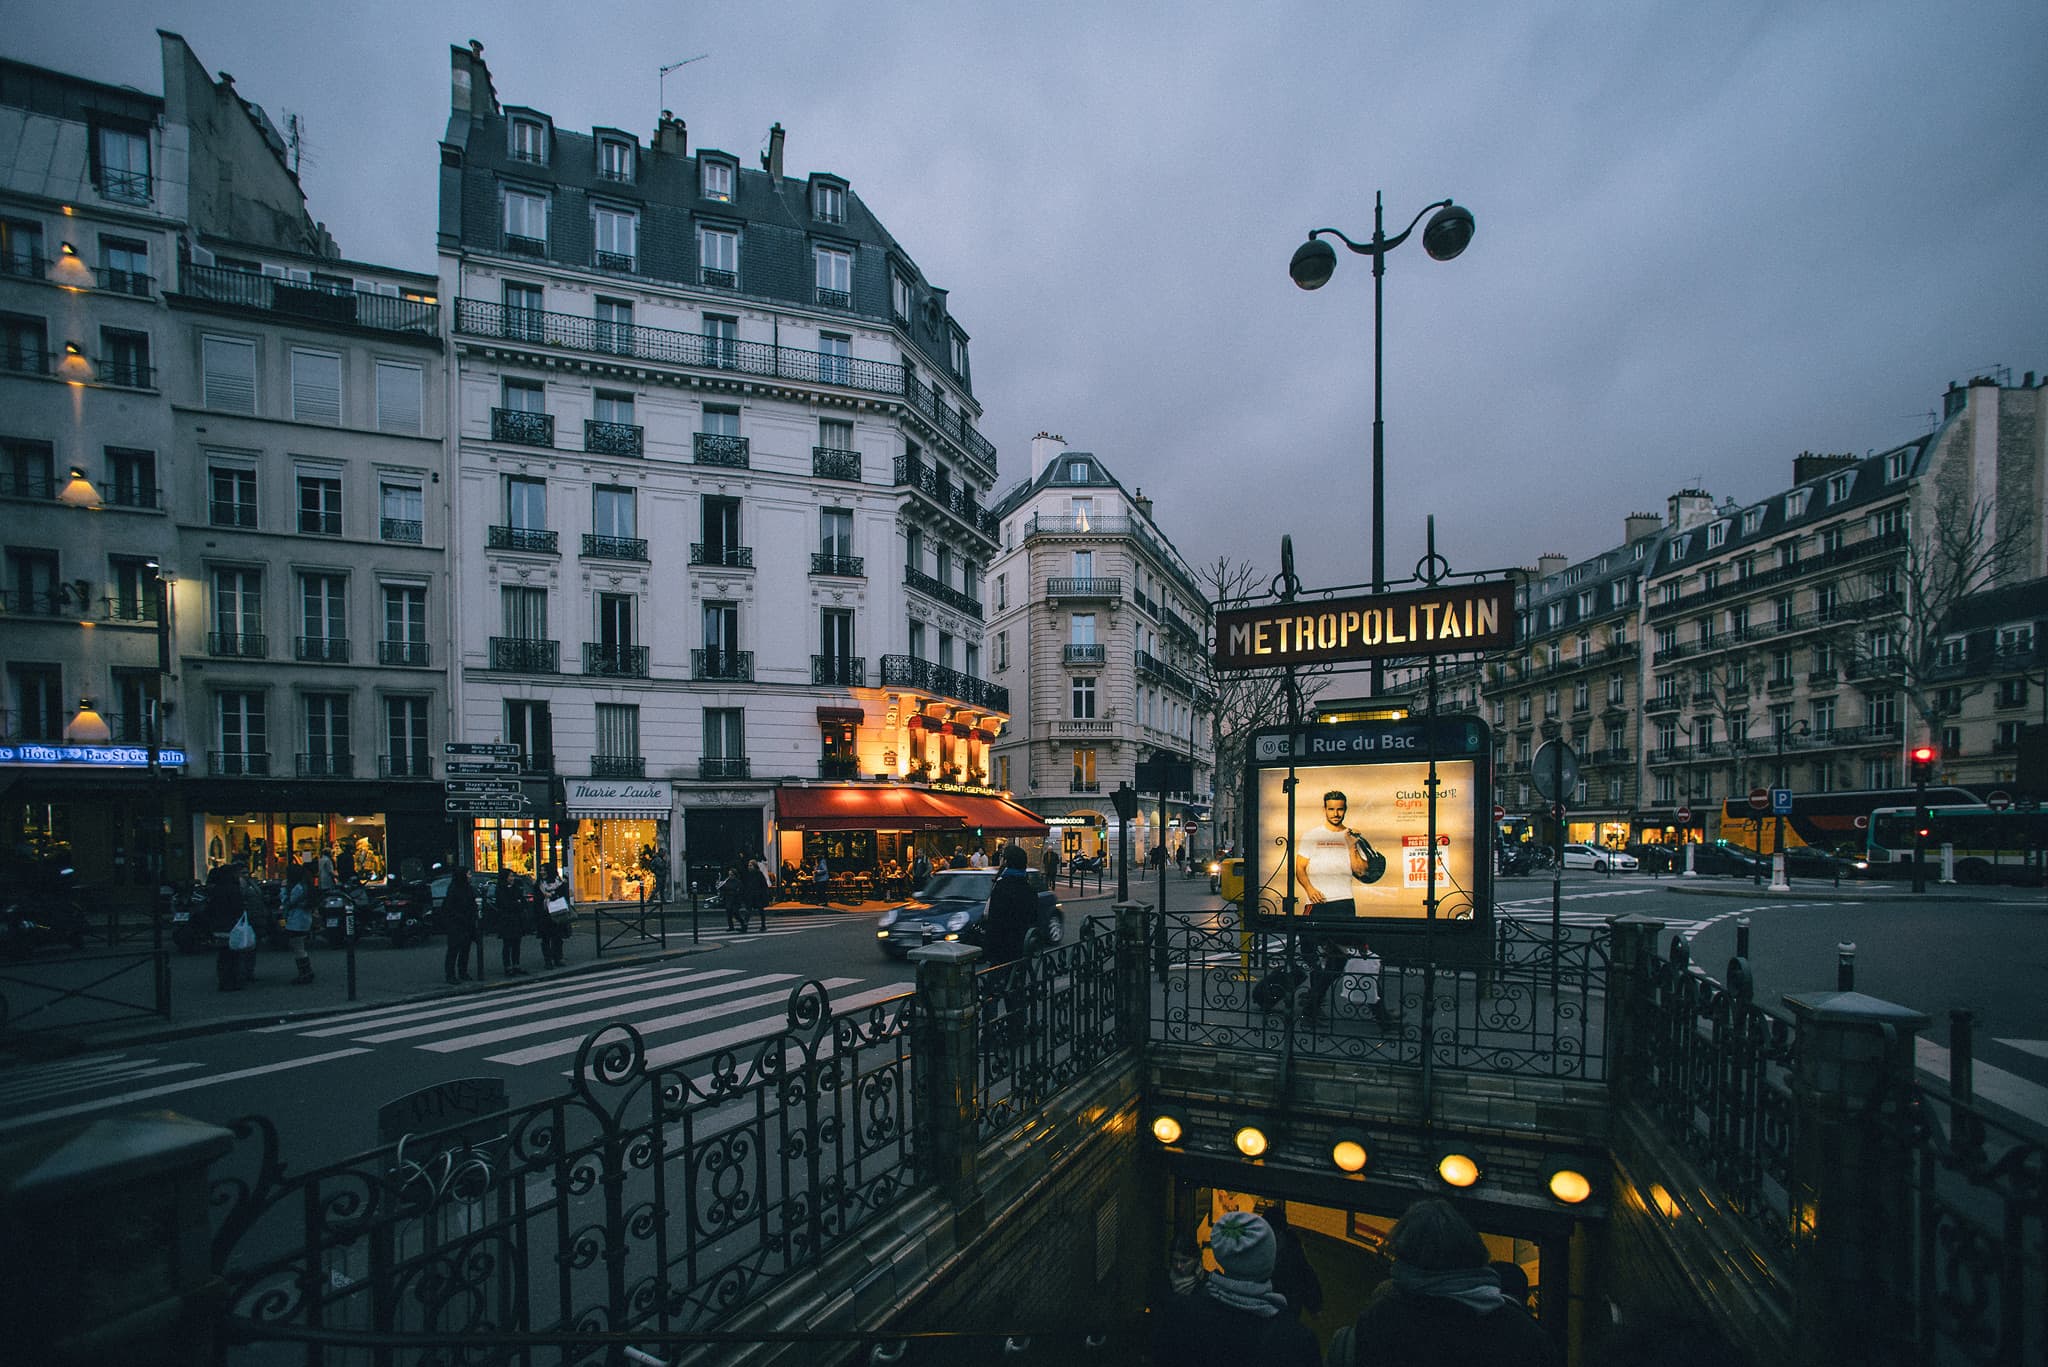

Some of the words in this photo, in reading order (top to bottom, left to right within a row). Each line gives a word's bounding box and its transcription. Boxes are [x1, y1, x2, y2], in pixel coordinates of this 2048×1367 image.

[1229, 598, 1498, 657] METROPOLITAIN
[1313, 738, 1346, 753] Rue
[1352, 736, 1375, 751] du
[1382, 735, 1415, 749] Bac
[22, 747, 58, 760] Hôtel
[86, 749, 108, 760] Bac
[112, 750, 125, 760] St
[128, 751, 182, 761] Gerain
[575, 785, 617, 798] Marie
[620, 785, 662, 798] Laure
[1396, 790, 1421, 799] Club
[1395, 799, 1422, 810] Gym
[1779, 793, 1787, 805] P
